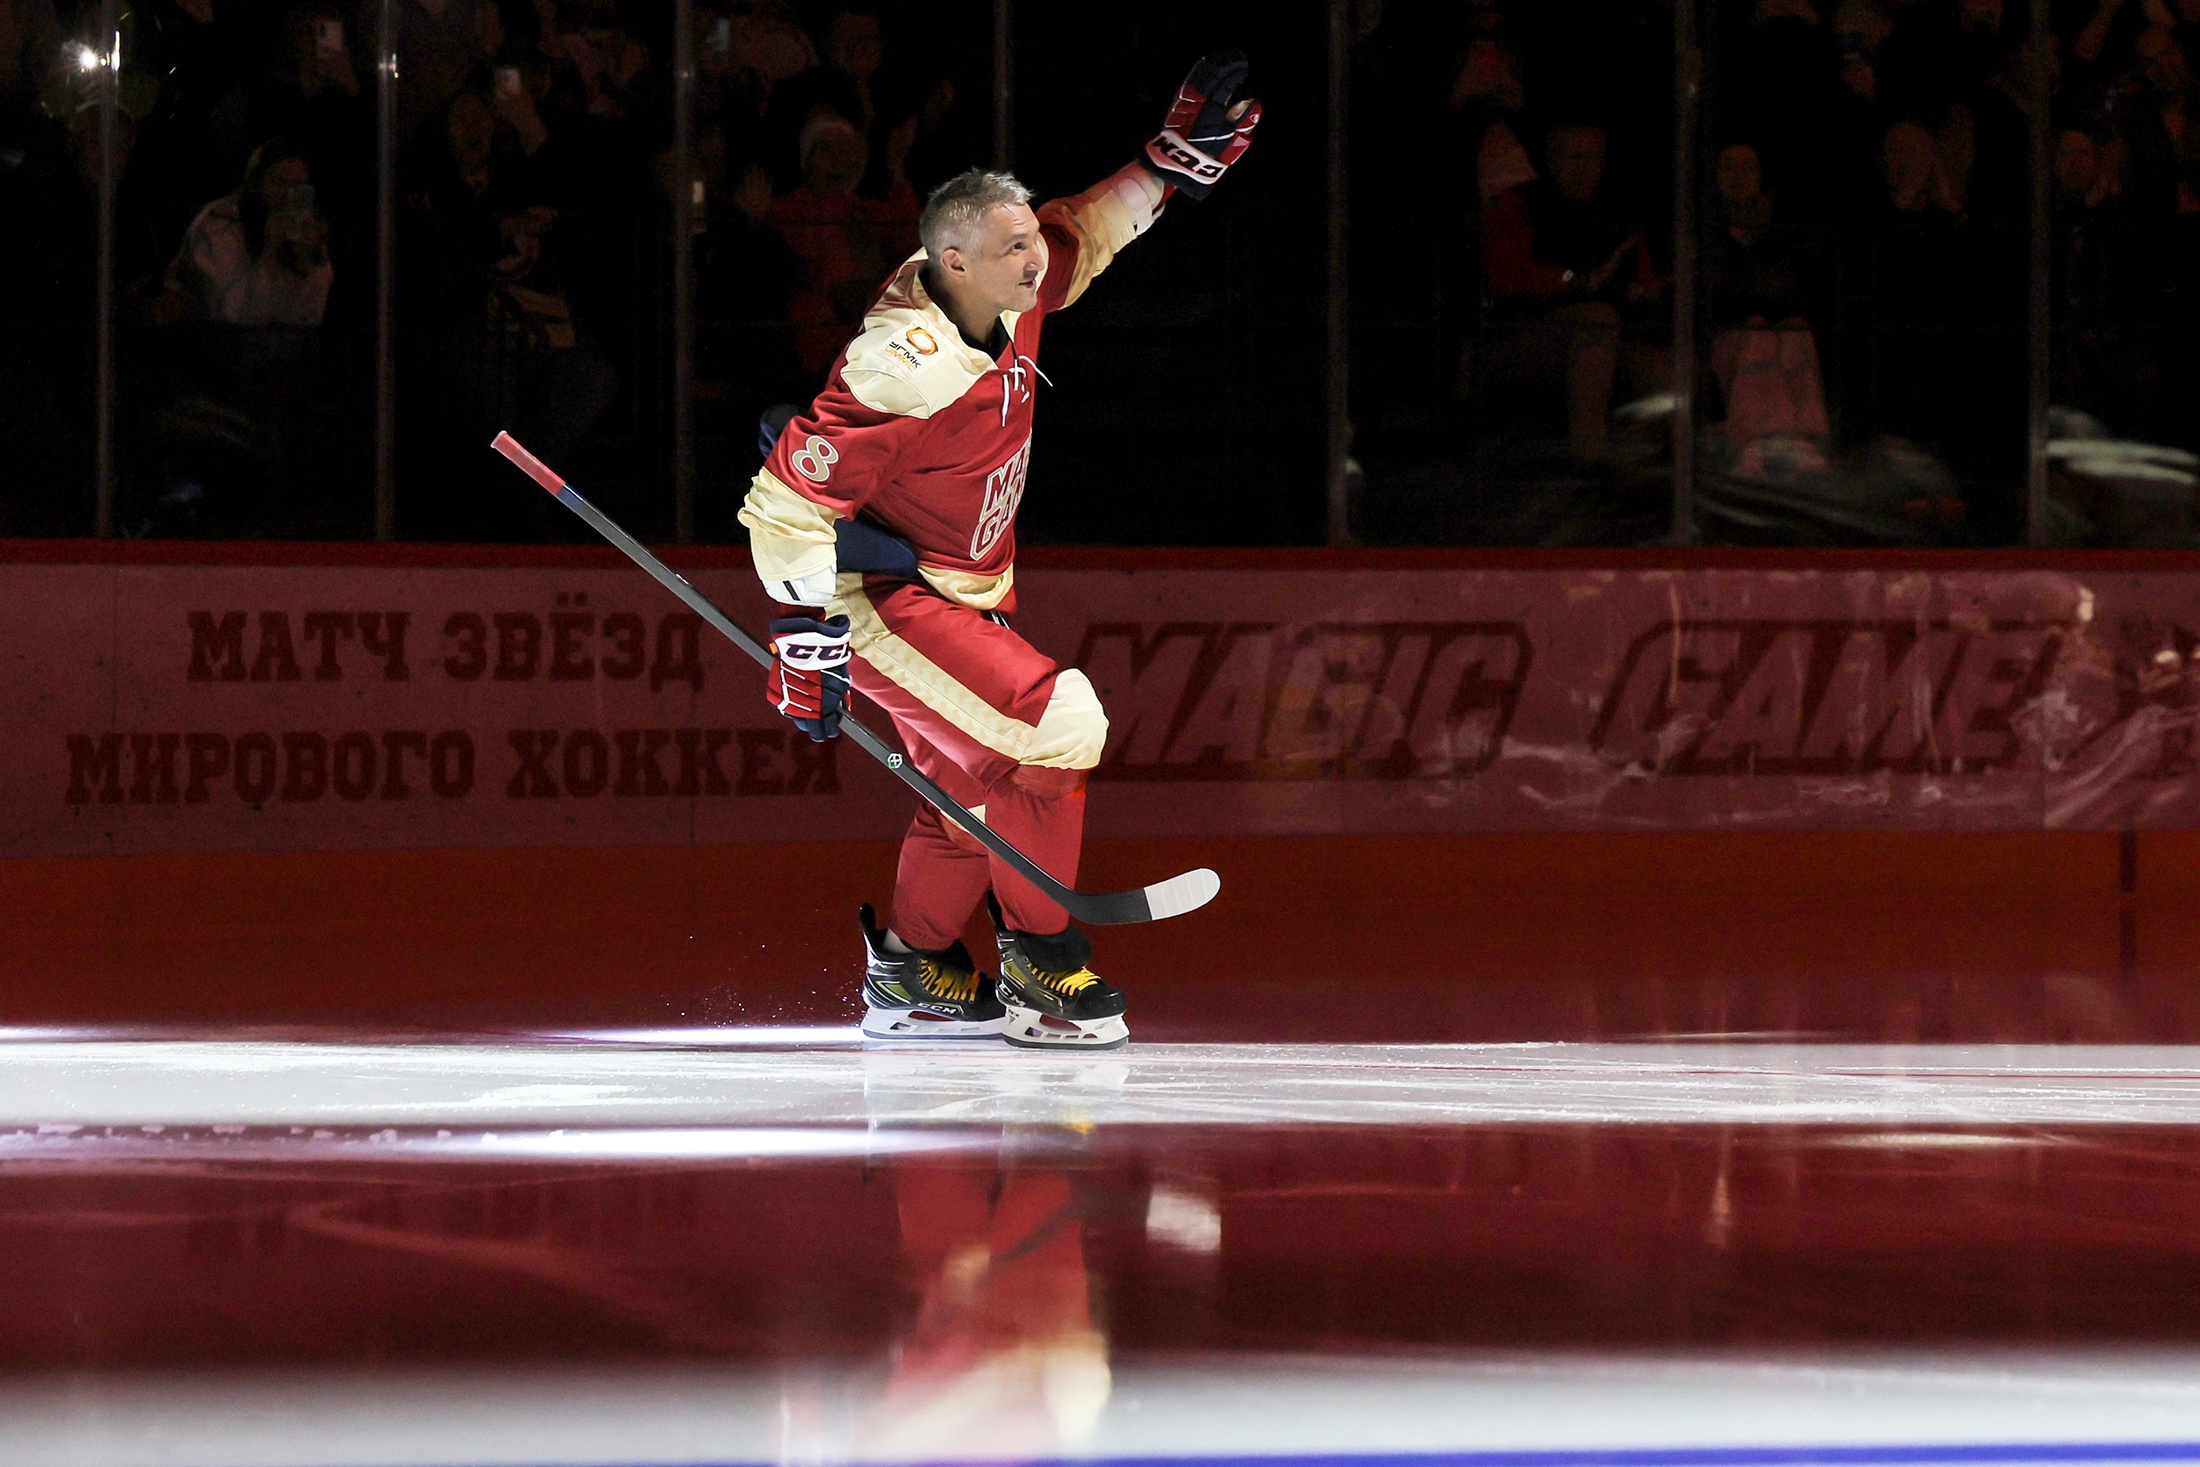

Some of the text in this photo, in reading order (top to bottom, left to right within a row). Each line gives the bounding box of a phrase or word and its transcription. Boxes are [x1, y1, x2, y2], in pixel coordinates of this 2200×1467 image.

[889, 341, 922, 368] УГМК
[792, 435, 839, 482] 8
[186, 592, 704, 693] МАТЧ ЗВЁЗД
[1073, 619, 2076, 782] MAGIC GAME
[65, 728, 842, 803] МИРОВОГО ХОККЕЯ
[917, 1002, 958, 1015] CCM
